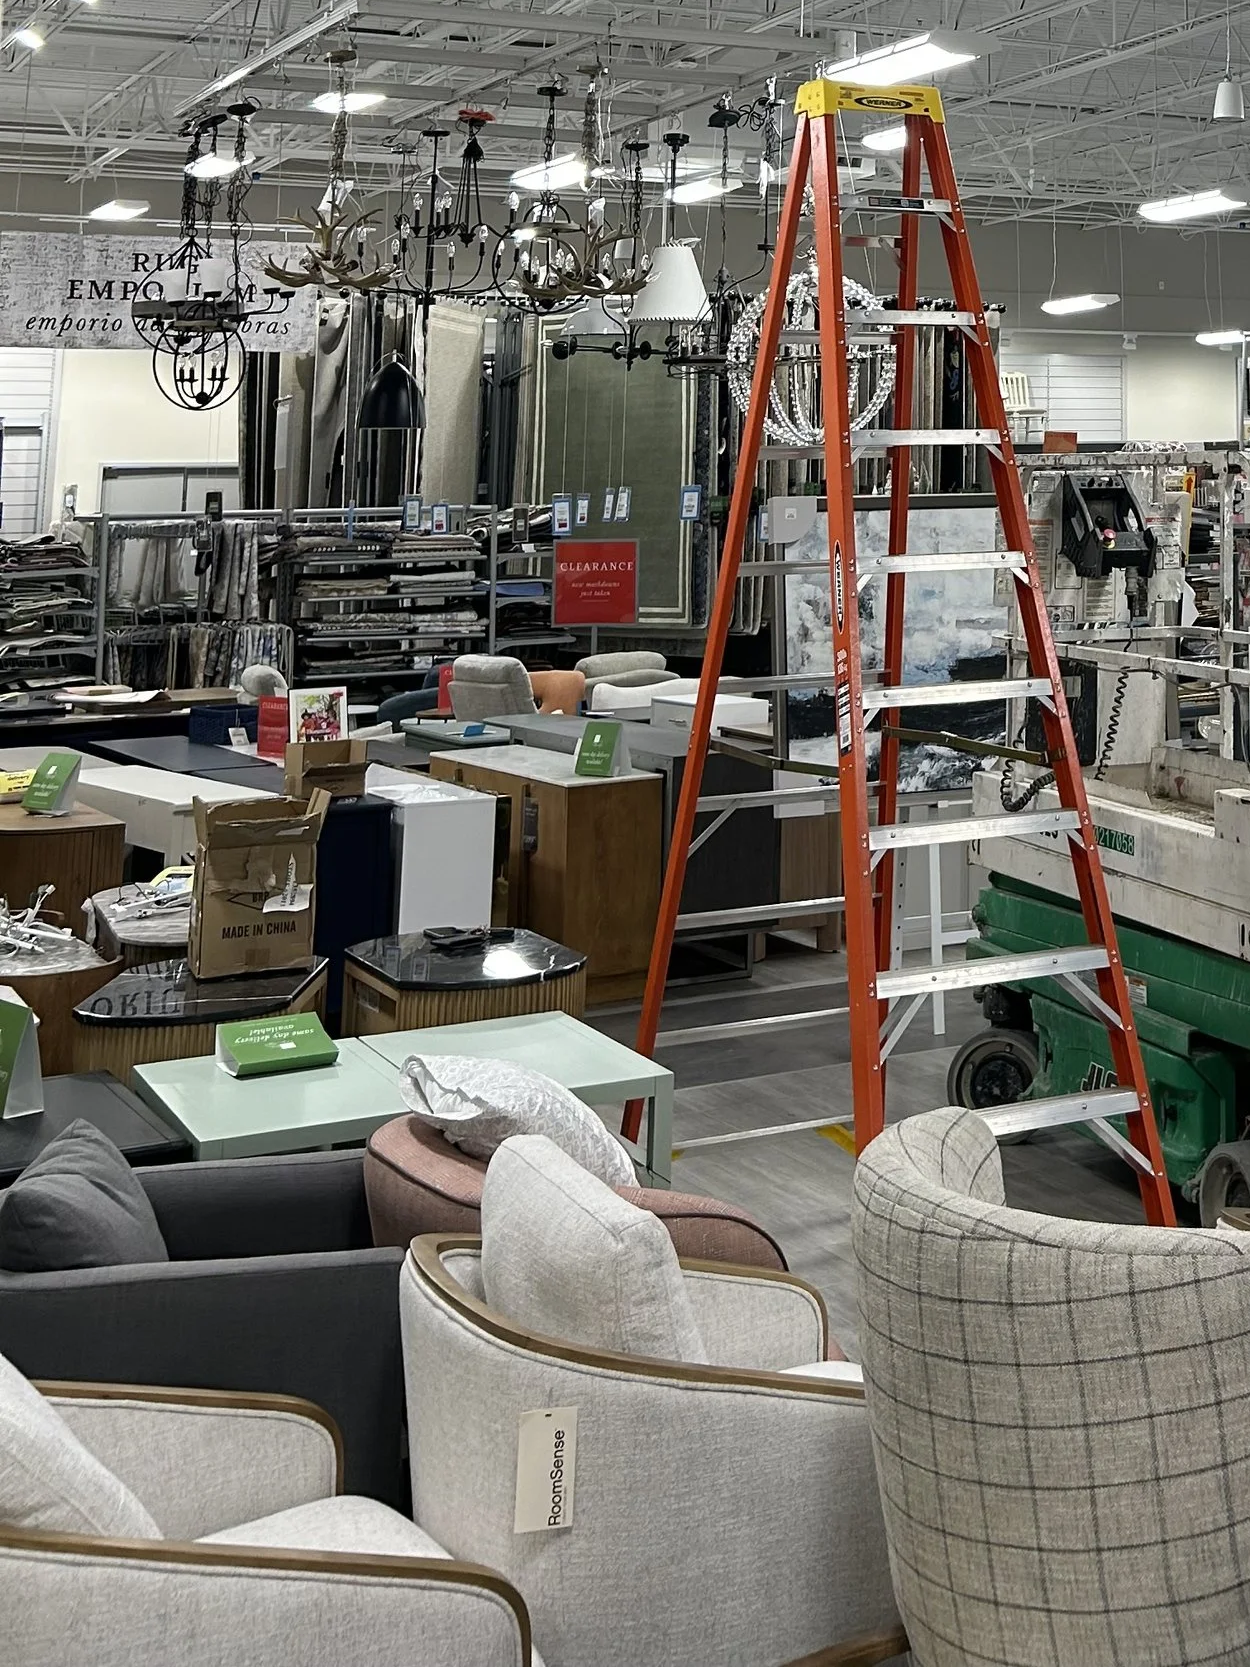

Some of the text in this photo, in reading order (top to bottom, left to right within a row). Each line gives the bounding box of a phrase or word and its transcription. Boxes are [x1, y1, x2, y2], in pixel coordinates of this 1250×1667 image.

[865, 98, 902, 107] WERNER
[25, 314, 123, 336] emporio
[560, 561, 634, 572] CLEARANCE
[221, 920, 297, 940] MADE IN CHINA
[291, 1028, 314, 1036] same
[548, 1429, 565, 1527] RoomSense
